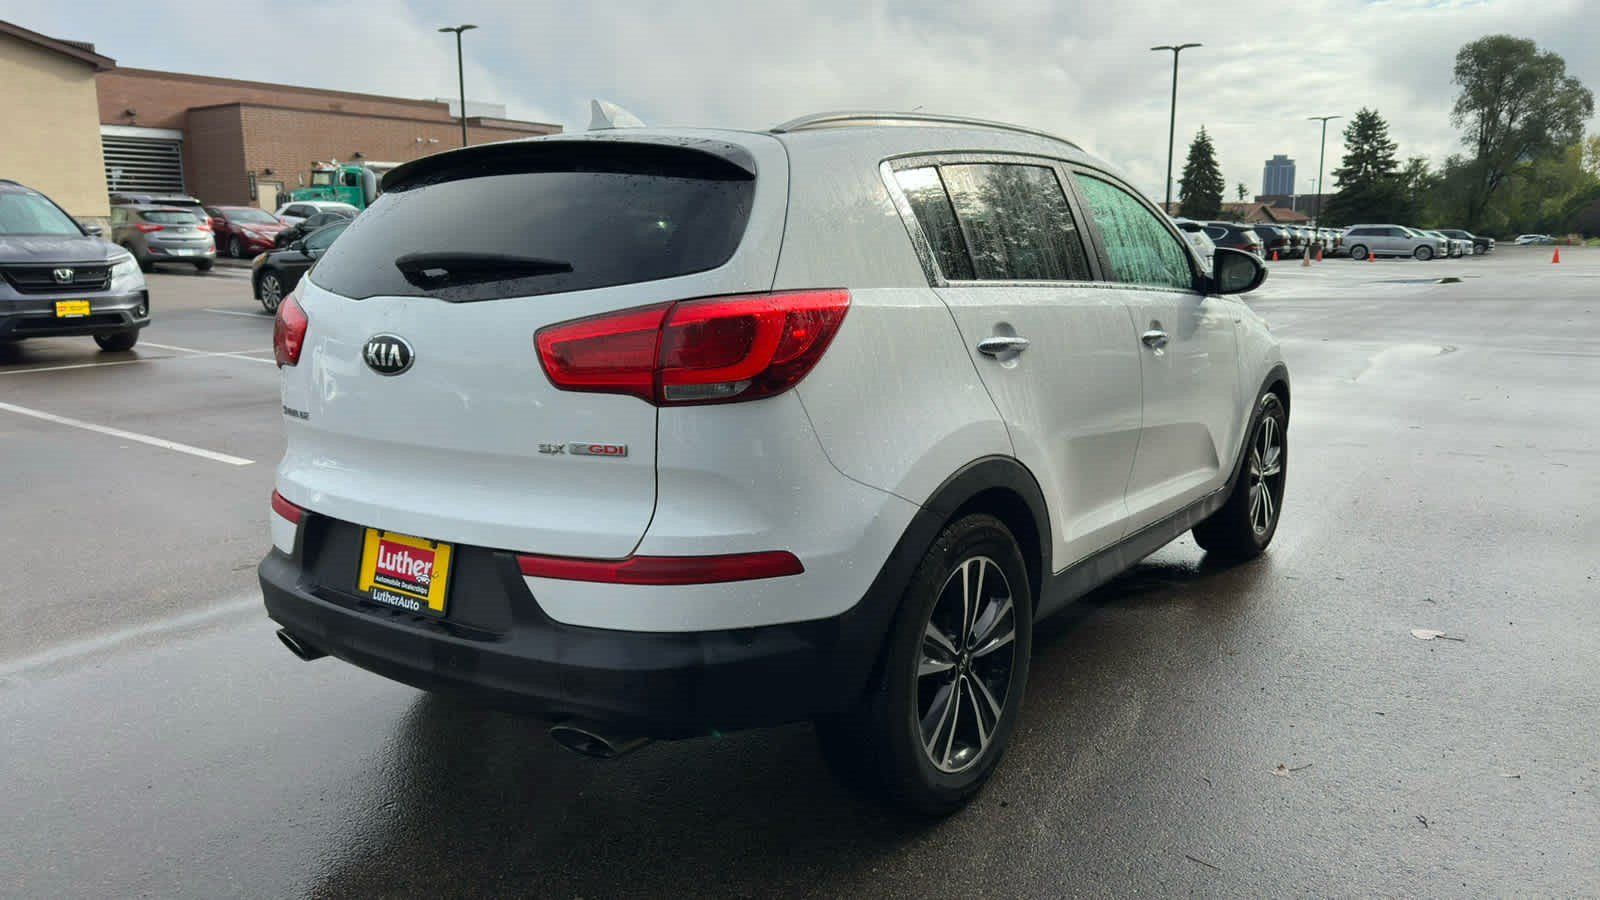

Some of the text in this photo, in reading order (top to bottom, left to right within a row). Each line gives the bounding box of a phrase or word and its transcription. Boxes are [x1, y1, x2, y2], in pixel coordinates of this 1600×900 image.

[368, 342, 404, 367] KIA
[588, 444, 624, 454] GDI
[378, 545, 432, 577] Luther
[373, 588, 419, 610] LutherAuto
